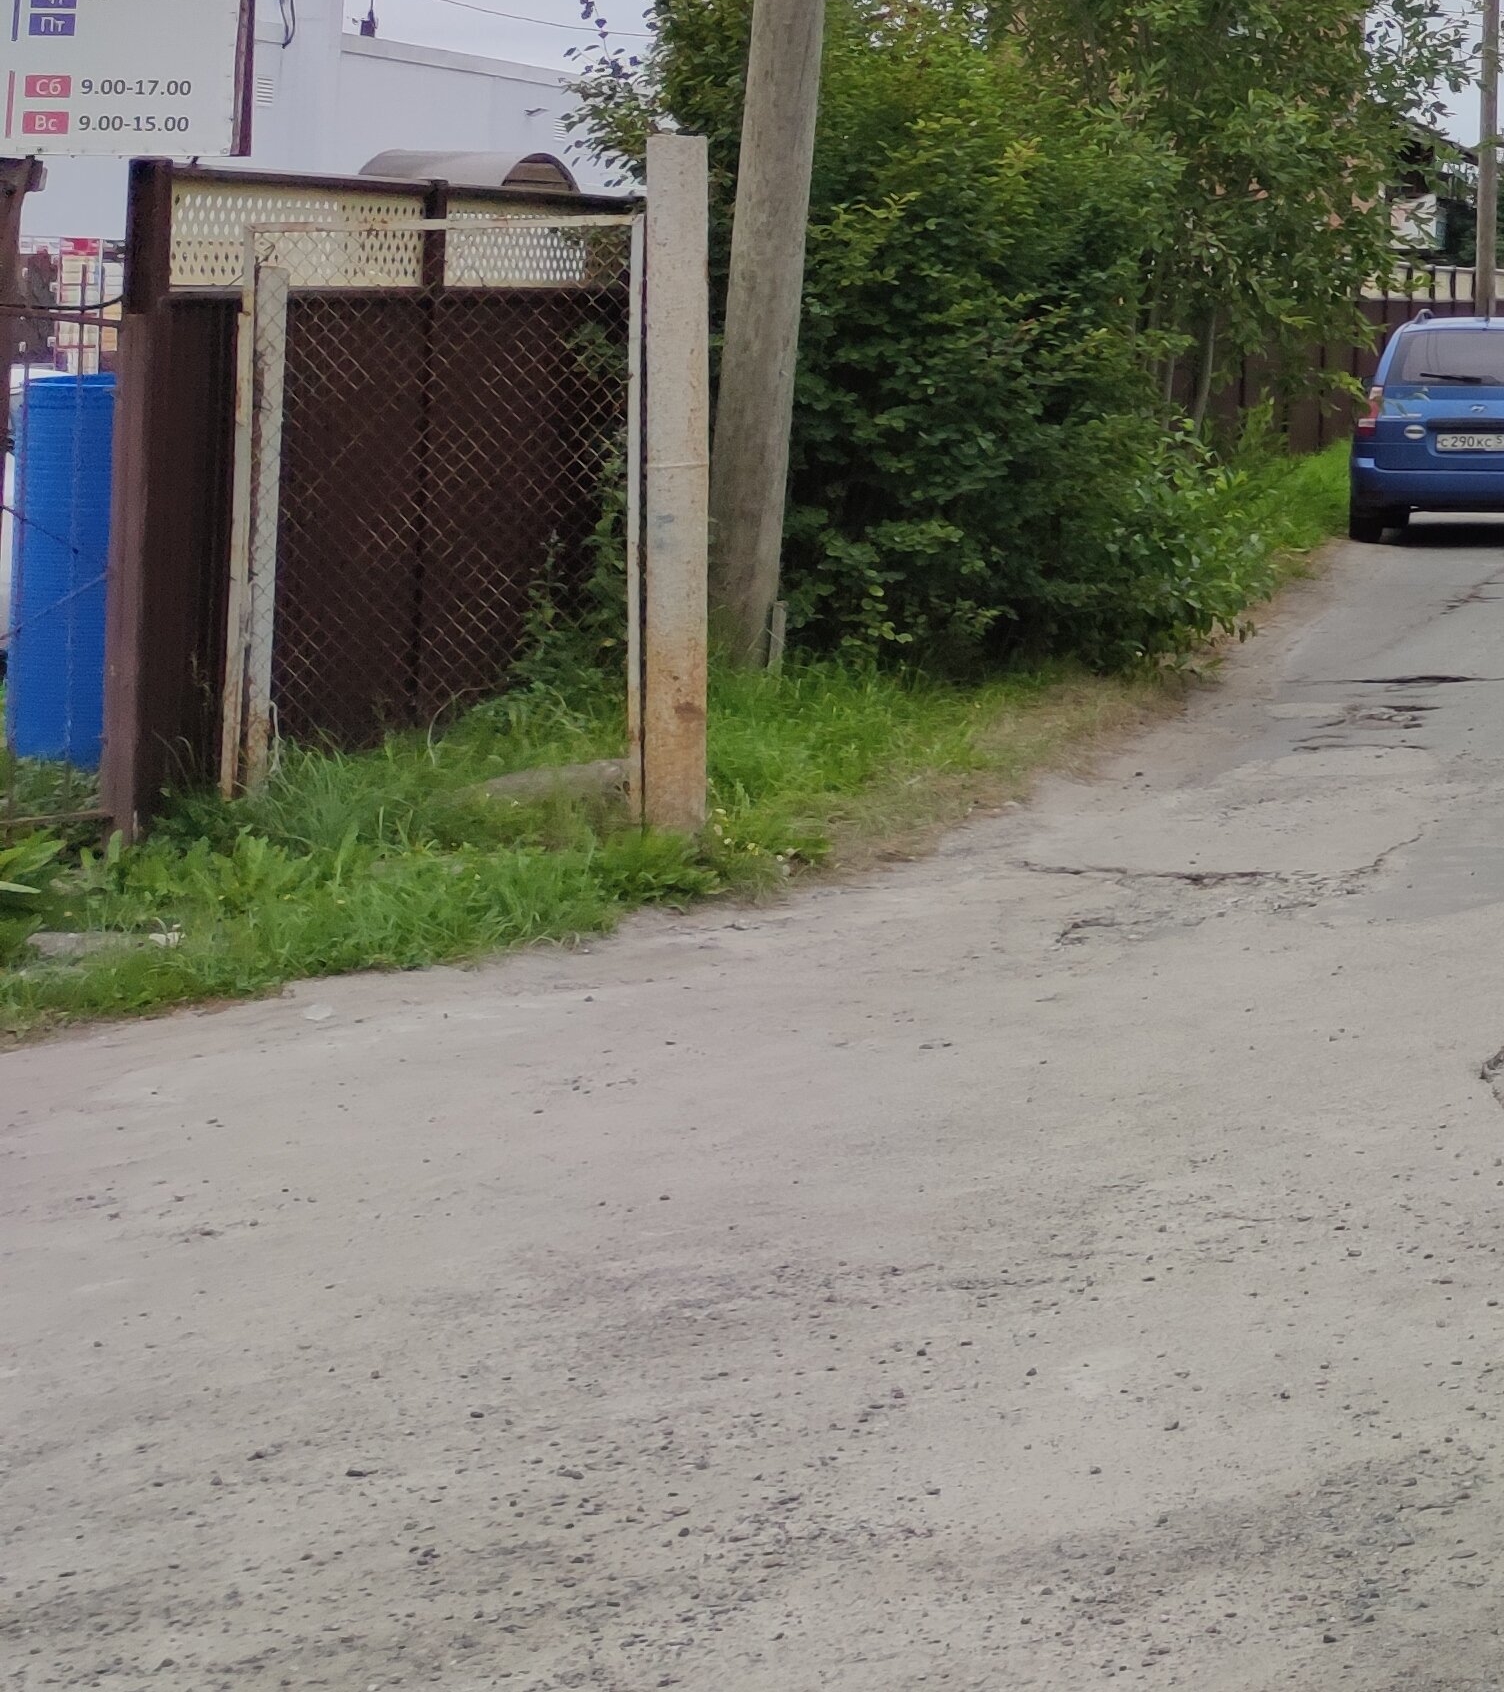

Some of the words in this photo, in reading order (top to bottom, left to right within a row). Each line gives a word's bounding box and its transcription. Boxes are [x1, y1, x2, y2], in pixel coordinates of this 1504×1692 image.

[40, 16, 66, 33] Пт
[35, 77, 62, 95] Сб
[80, 79, 192, 96] 9.00-17.00
[34, 114, 57, 131] Вс
[78, 115, 190, 132] 9.00-15.00
